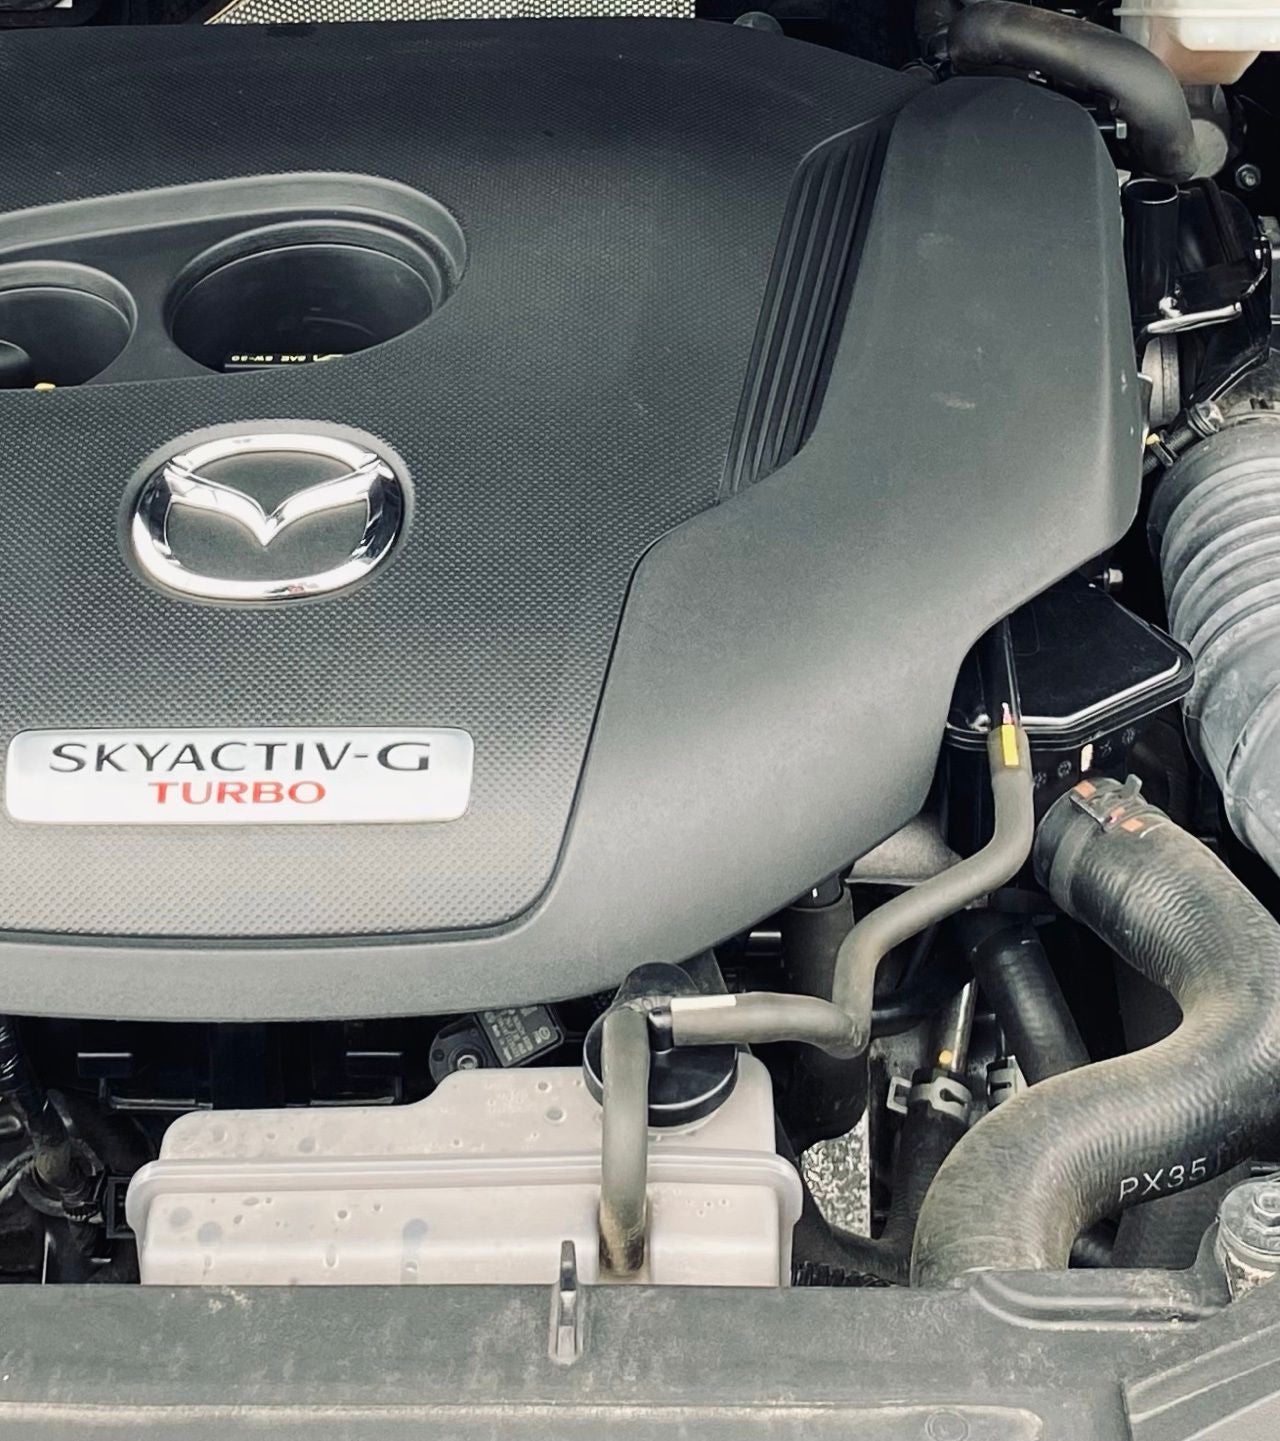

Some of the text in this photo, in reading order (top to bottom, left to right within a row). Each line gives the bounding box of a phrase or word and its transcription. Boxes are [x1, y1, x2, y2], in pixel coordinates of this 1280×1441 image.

[49, 741, 431, 773] SKYACTIV-G
[148, 781, 327, 805] TURBO
[1118, 1157, 1207, 1203] PX35
